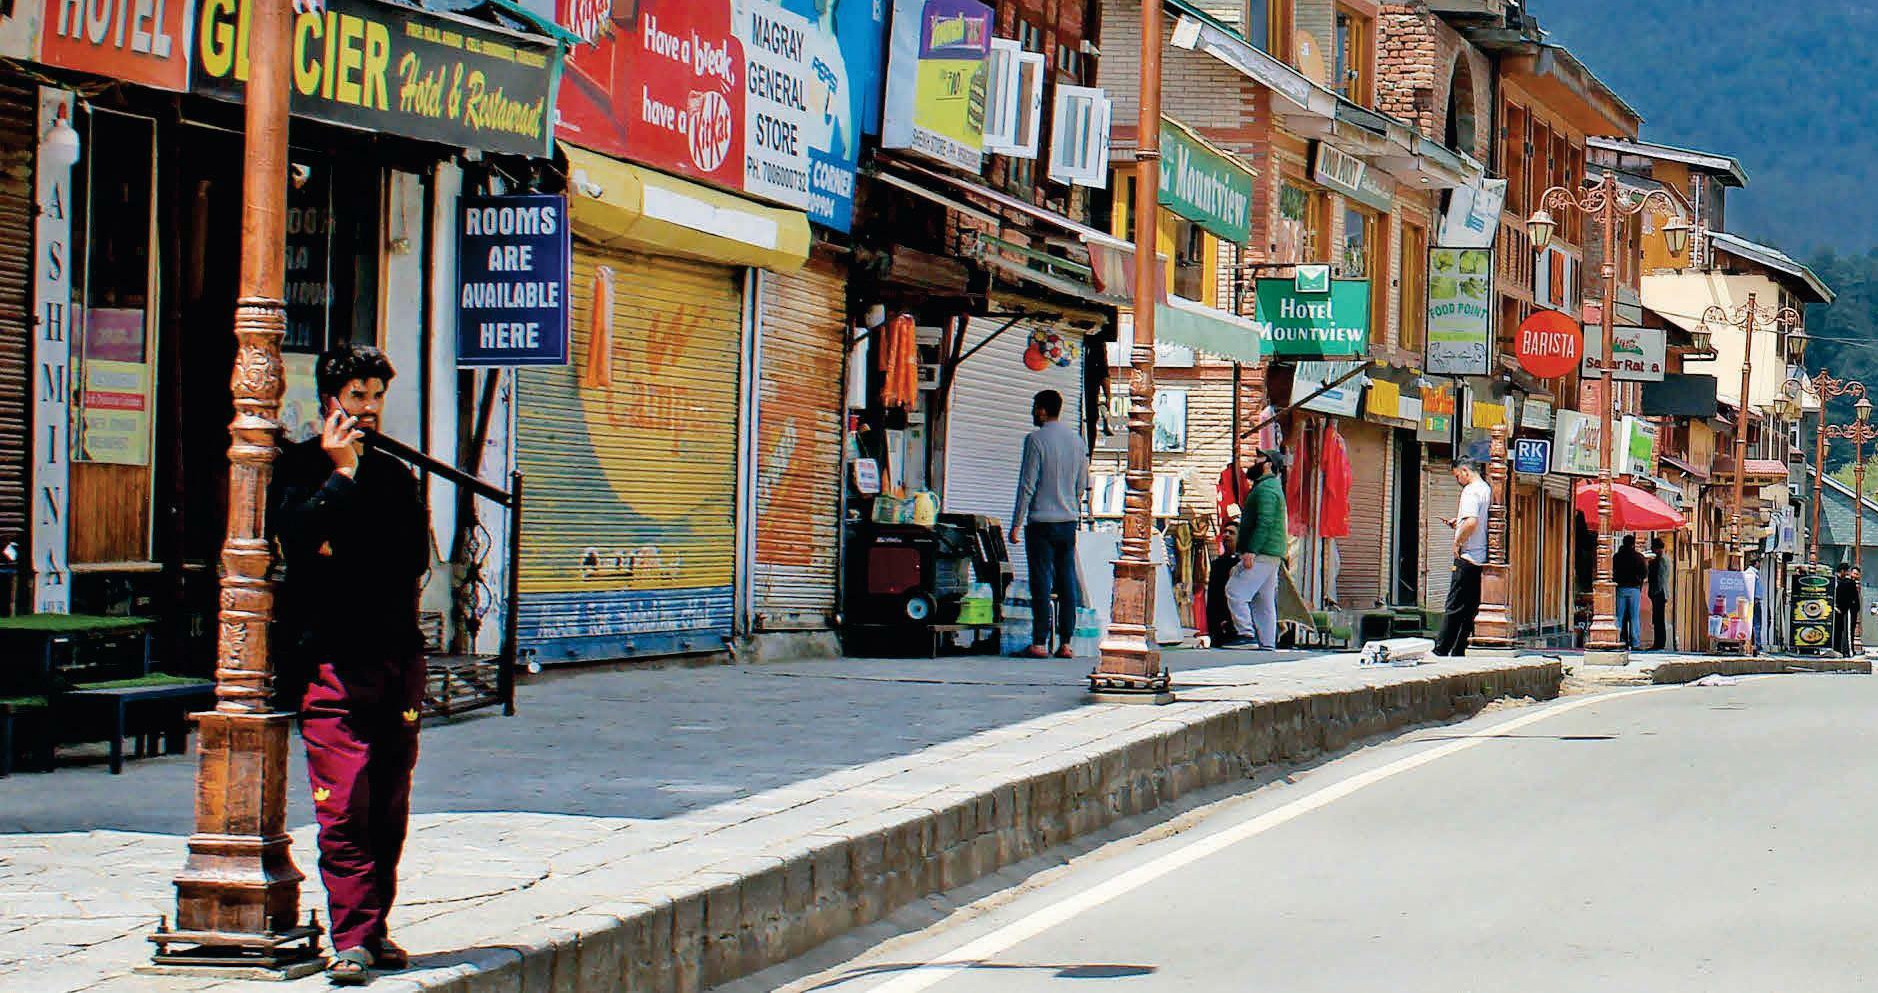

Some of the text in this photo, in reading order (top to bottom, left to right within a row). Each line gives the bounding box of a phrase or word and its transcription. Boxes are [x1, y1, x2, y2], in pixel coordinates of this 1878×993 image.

[644, 13, 735, 85] Have a break,
[753, 13, 804, 63] MAGRAY
[400, 52, 446, 119] Hotel
[448, 62, 463, 120] &
[464, 70, 545, 140] Restaurant
[749, 62, 806, 112] GENERAL
[642, 85, 731, 171] have a KitKat
[756, 113, 799, 157] STORE
[1176, 144, 1247, 229] Mountview
[466, 205, 557, 237] ROOMS
[488, 246, 533, 273] ARE
[462, 281, 560, 309] AVAILABLE
[1429, 303, 1488, 320] FOOD POINT
[40, 120, 66, 586] ASHMINA
[479, 322, 540, 349] HERE
[1522, 330, 1575, 358] BARISTA
[1586, 357, 1622, 370] Saar
[1519, 442, 1543, 458] RK
